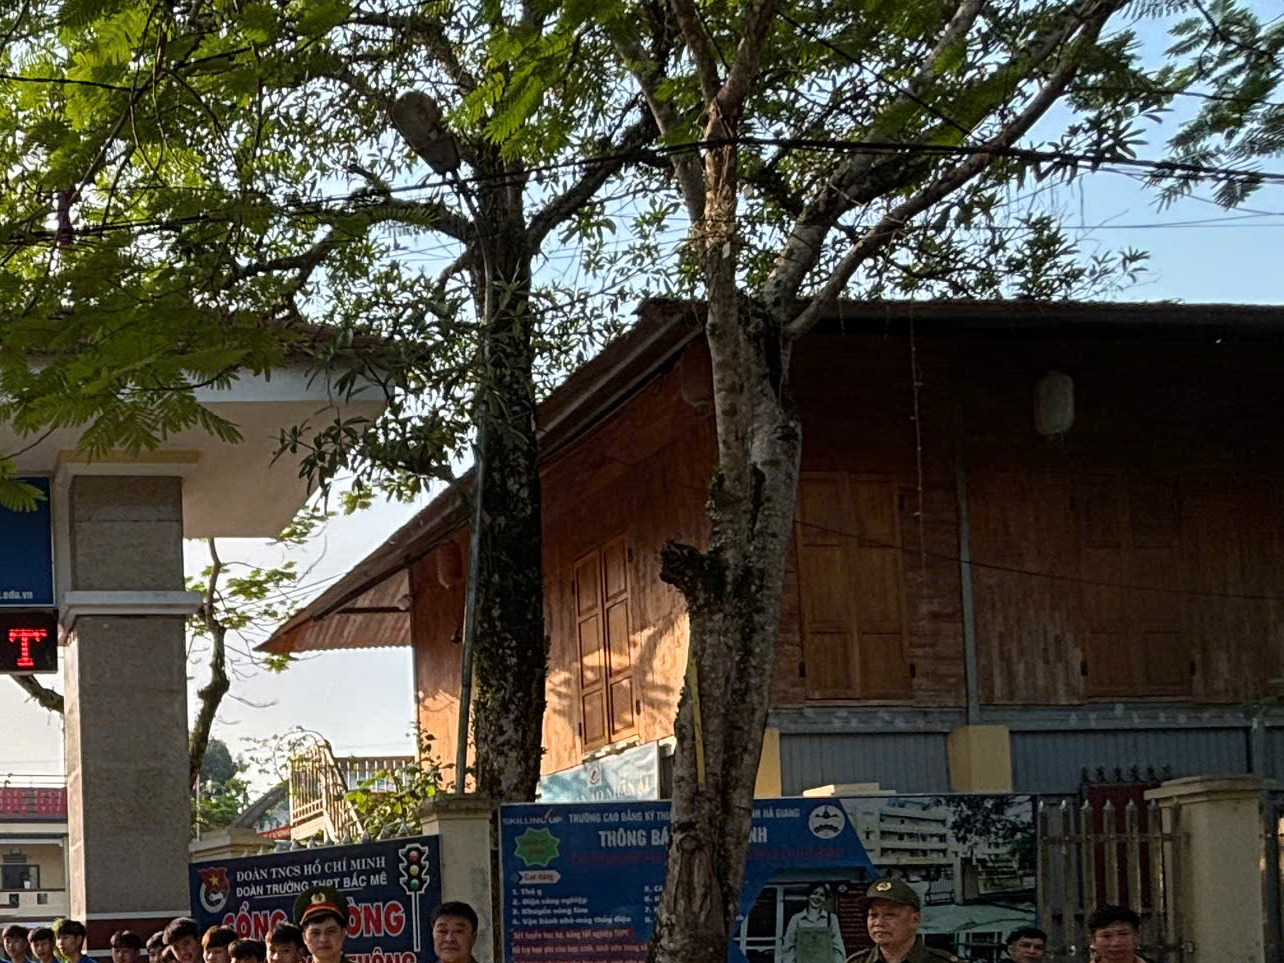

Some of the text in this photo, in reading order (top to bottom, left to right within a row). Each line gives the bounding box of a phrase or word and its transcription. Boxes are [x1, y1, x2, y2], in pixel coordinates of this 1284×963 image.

[598, 827, 647, 848] THÔNG
[651, 825, 670, 846] BÁ
[236, 856, 386, 882] ĐOÀN TNCS HỒ CHÍ MINH
[236, 885, 264, 897] ĐOÀN
[266, 879, 309, 895] TRƯỜNG
[343, 873, 367, 888] BẮC
[369, 873, 388, 886] MÊ
